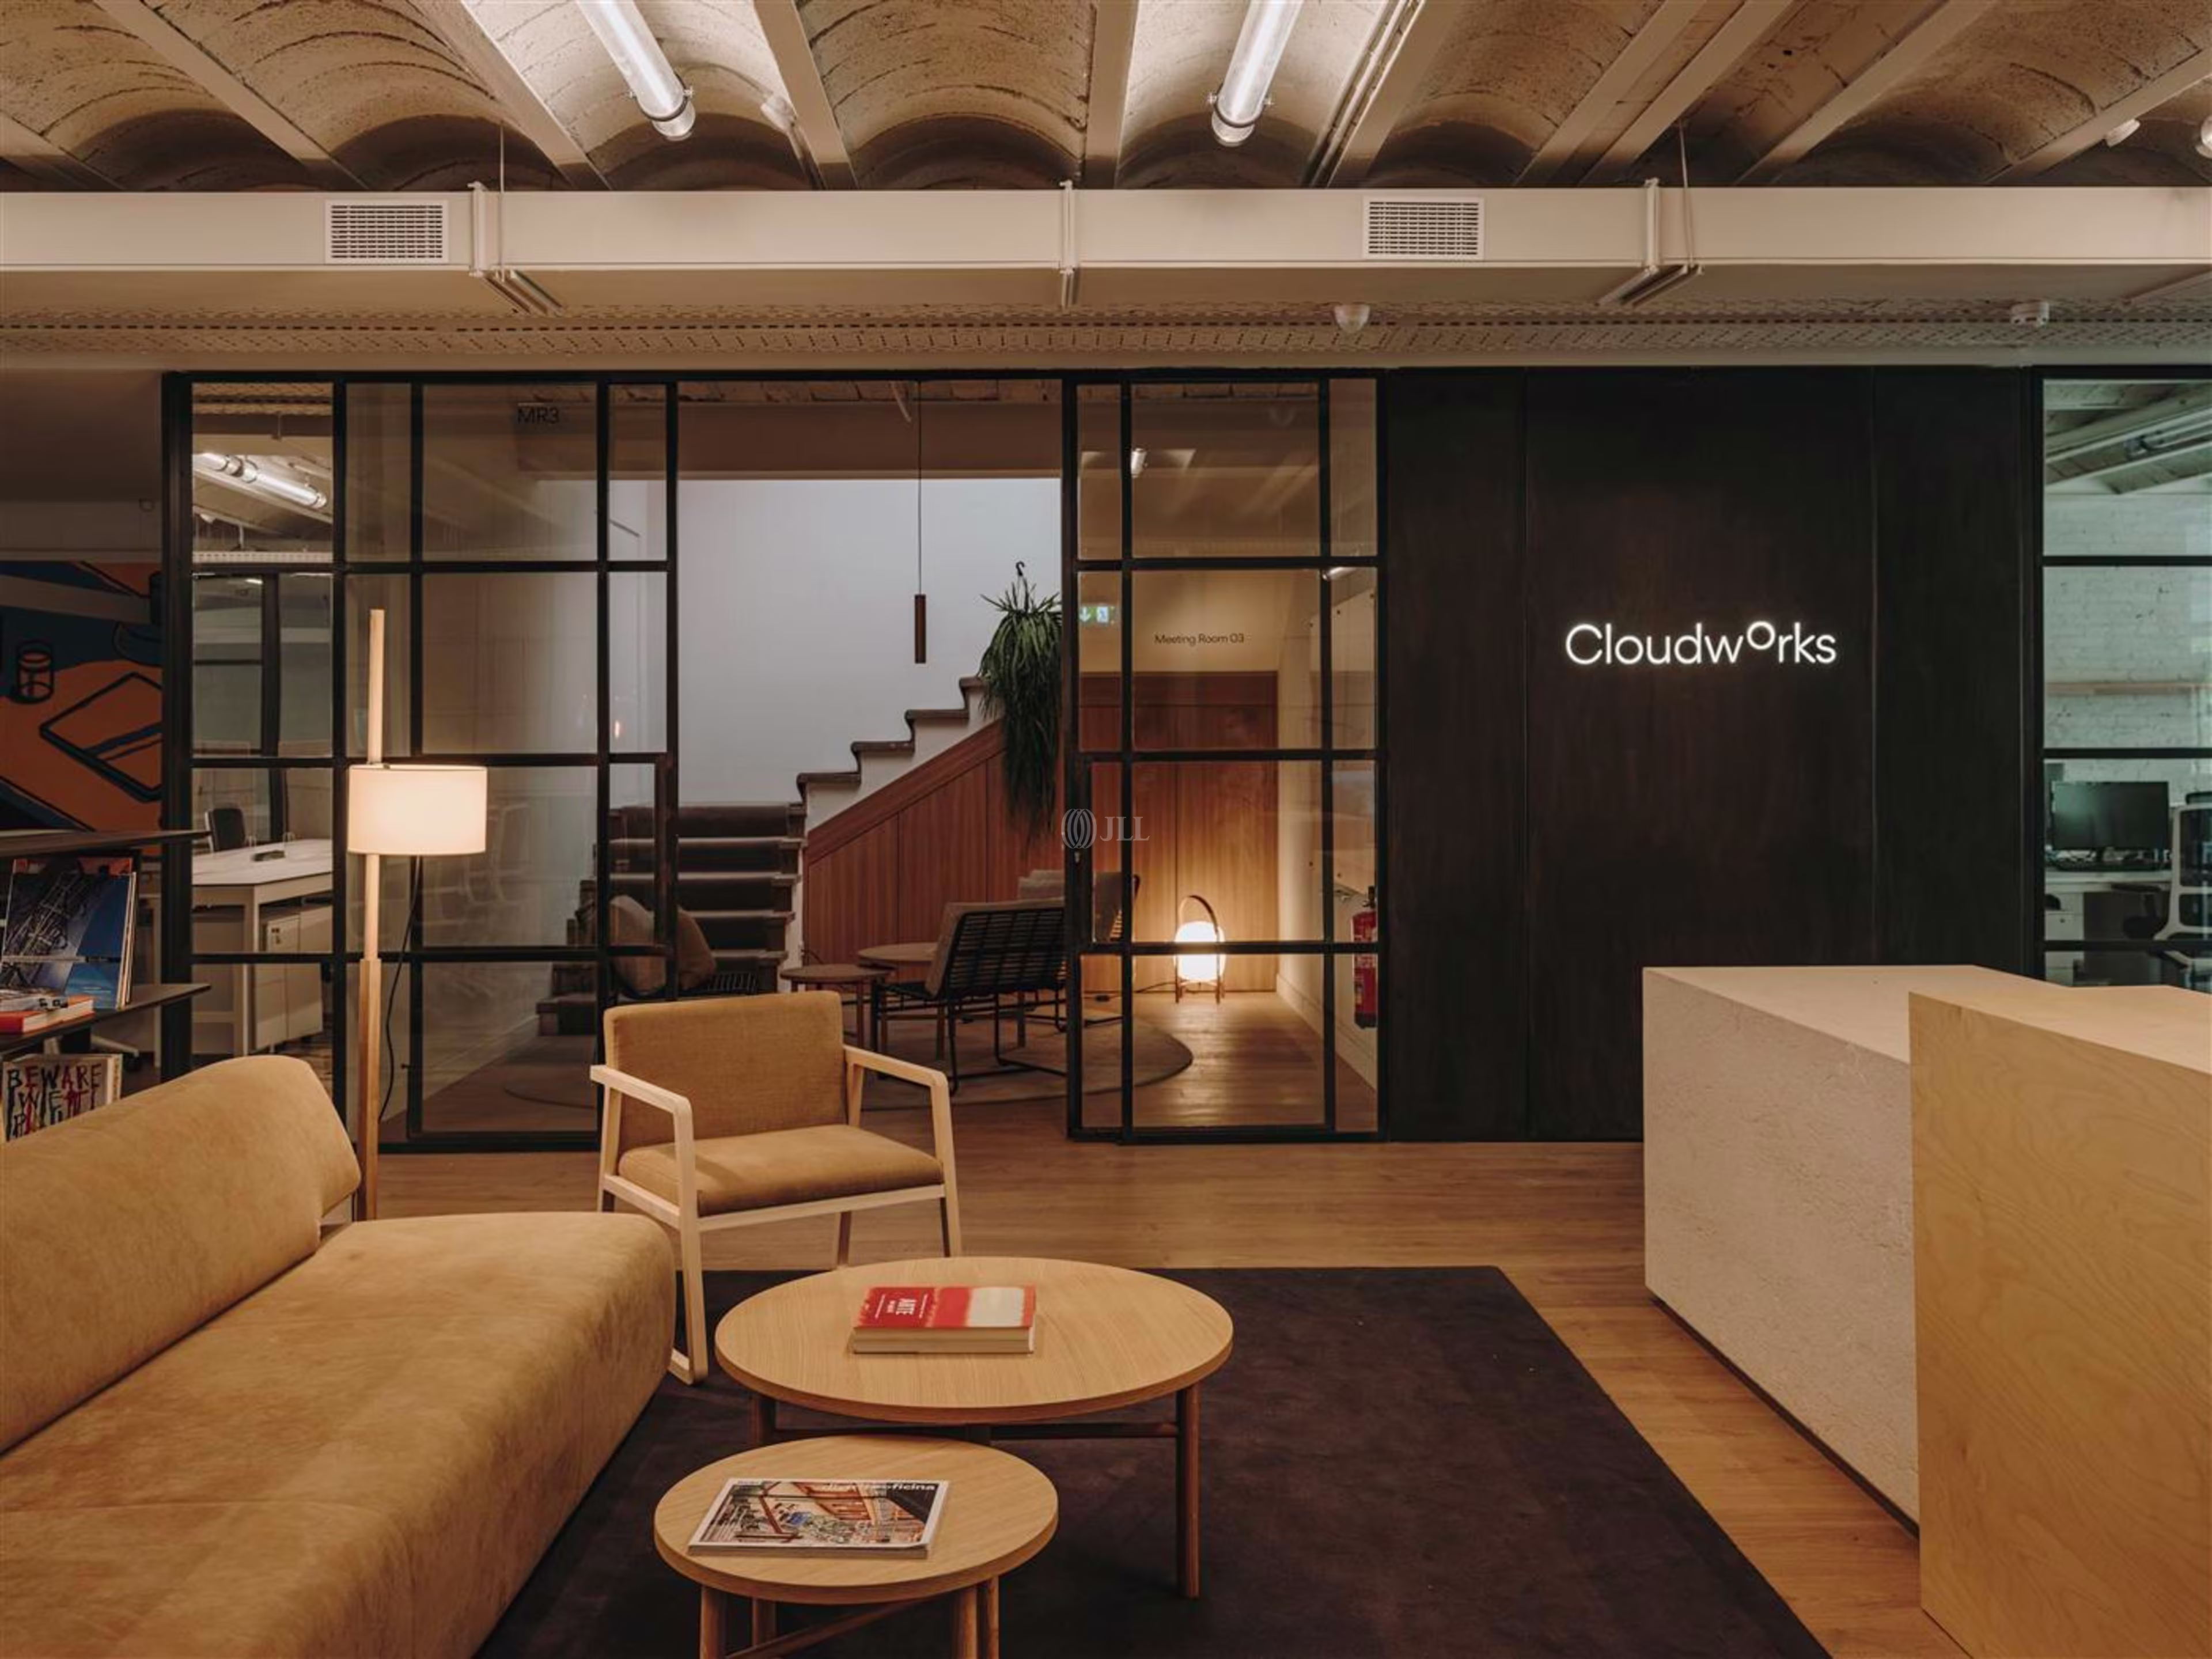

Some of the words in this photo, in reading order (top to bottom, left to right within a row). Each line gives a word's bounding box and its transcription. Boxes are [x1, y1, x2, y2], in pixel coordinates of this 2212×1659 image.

[517, 406, 559, 425] MR3
[1154, 634, 1196, 646] Meeting
[1199, 633, 1228, 644] Room
[1230, 633, 1244, 644] 03
[1565, 621, 1836, 665] Cloudworks
[7, 1063, 102, 1089] BEWARE
